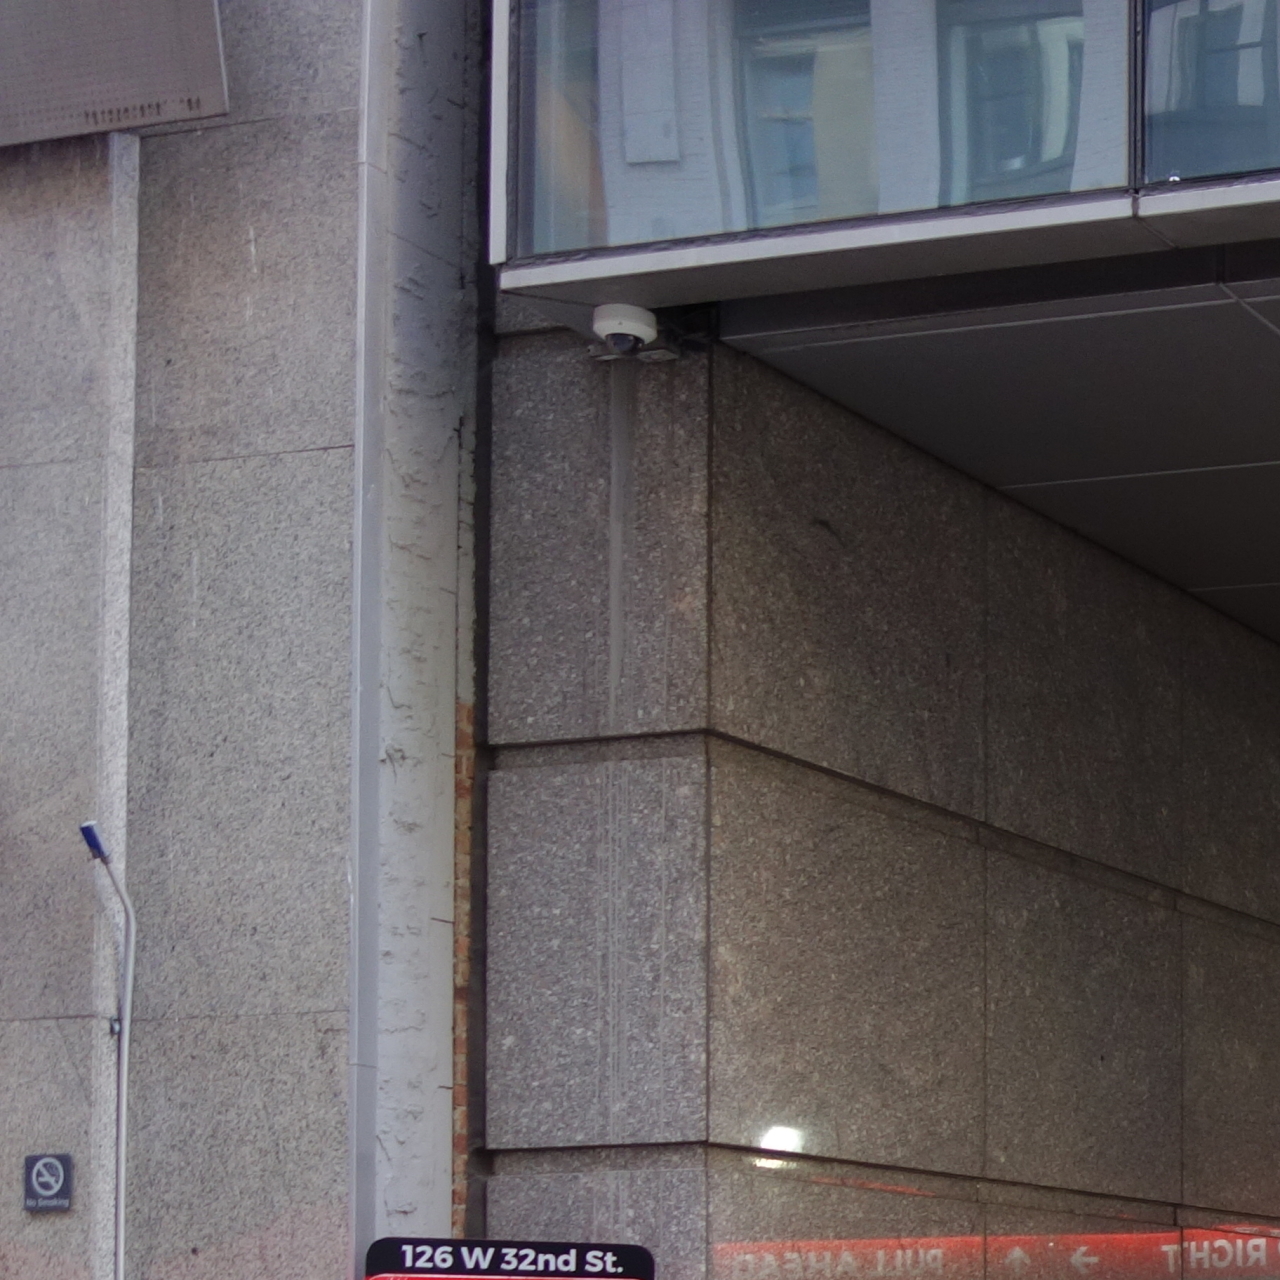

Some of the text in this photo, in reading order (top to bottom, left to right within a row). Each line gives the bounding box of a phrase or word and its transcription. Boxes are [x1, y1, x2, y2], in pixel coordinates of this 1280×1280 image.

[401, 1245, 624, 1274] 126 W 32nd St.
